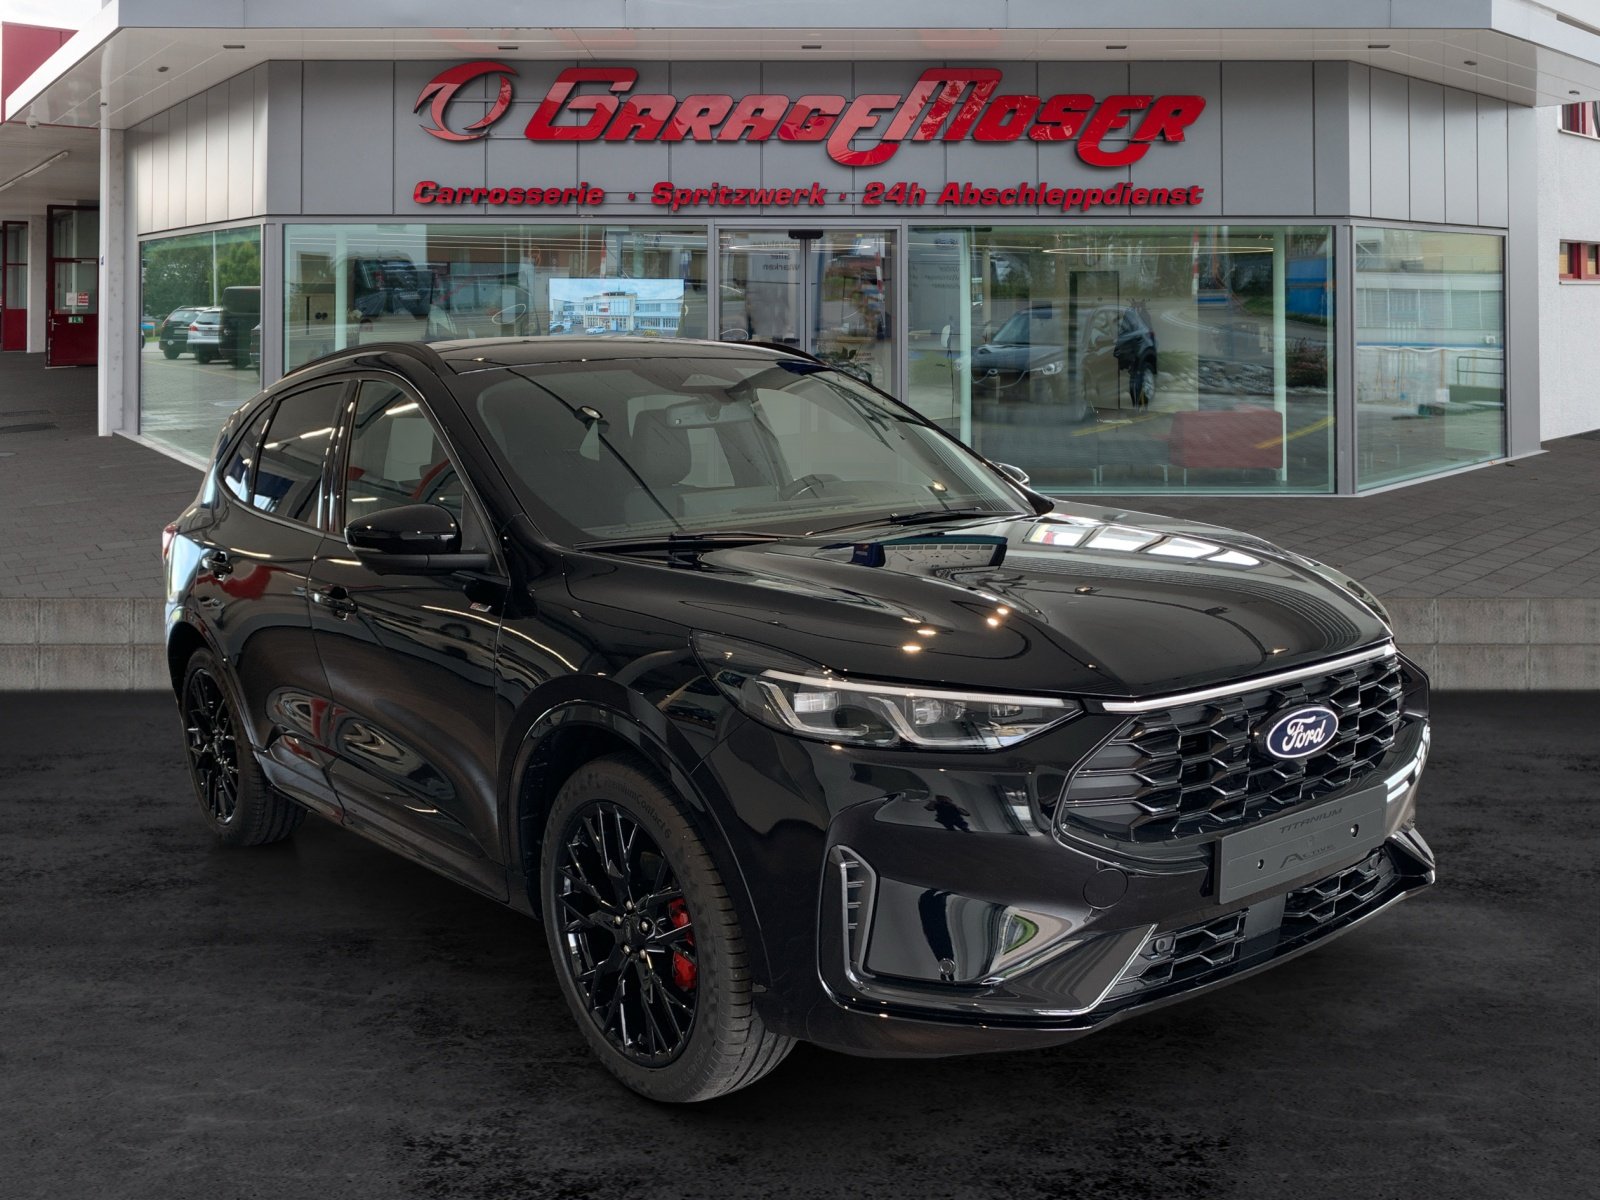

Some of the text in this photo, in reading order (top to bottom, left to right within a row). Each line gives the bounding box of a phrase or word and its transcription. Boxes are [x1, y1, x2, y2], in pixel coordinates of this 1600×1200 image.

[413, 180, 1204, 212] Carrosserie Spritzwerk 24h Abschleppdienst
[1279, 807, 1343, 834] TITANIUM
